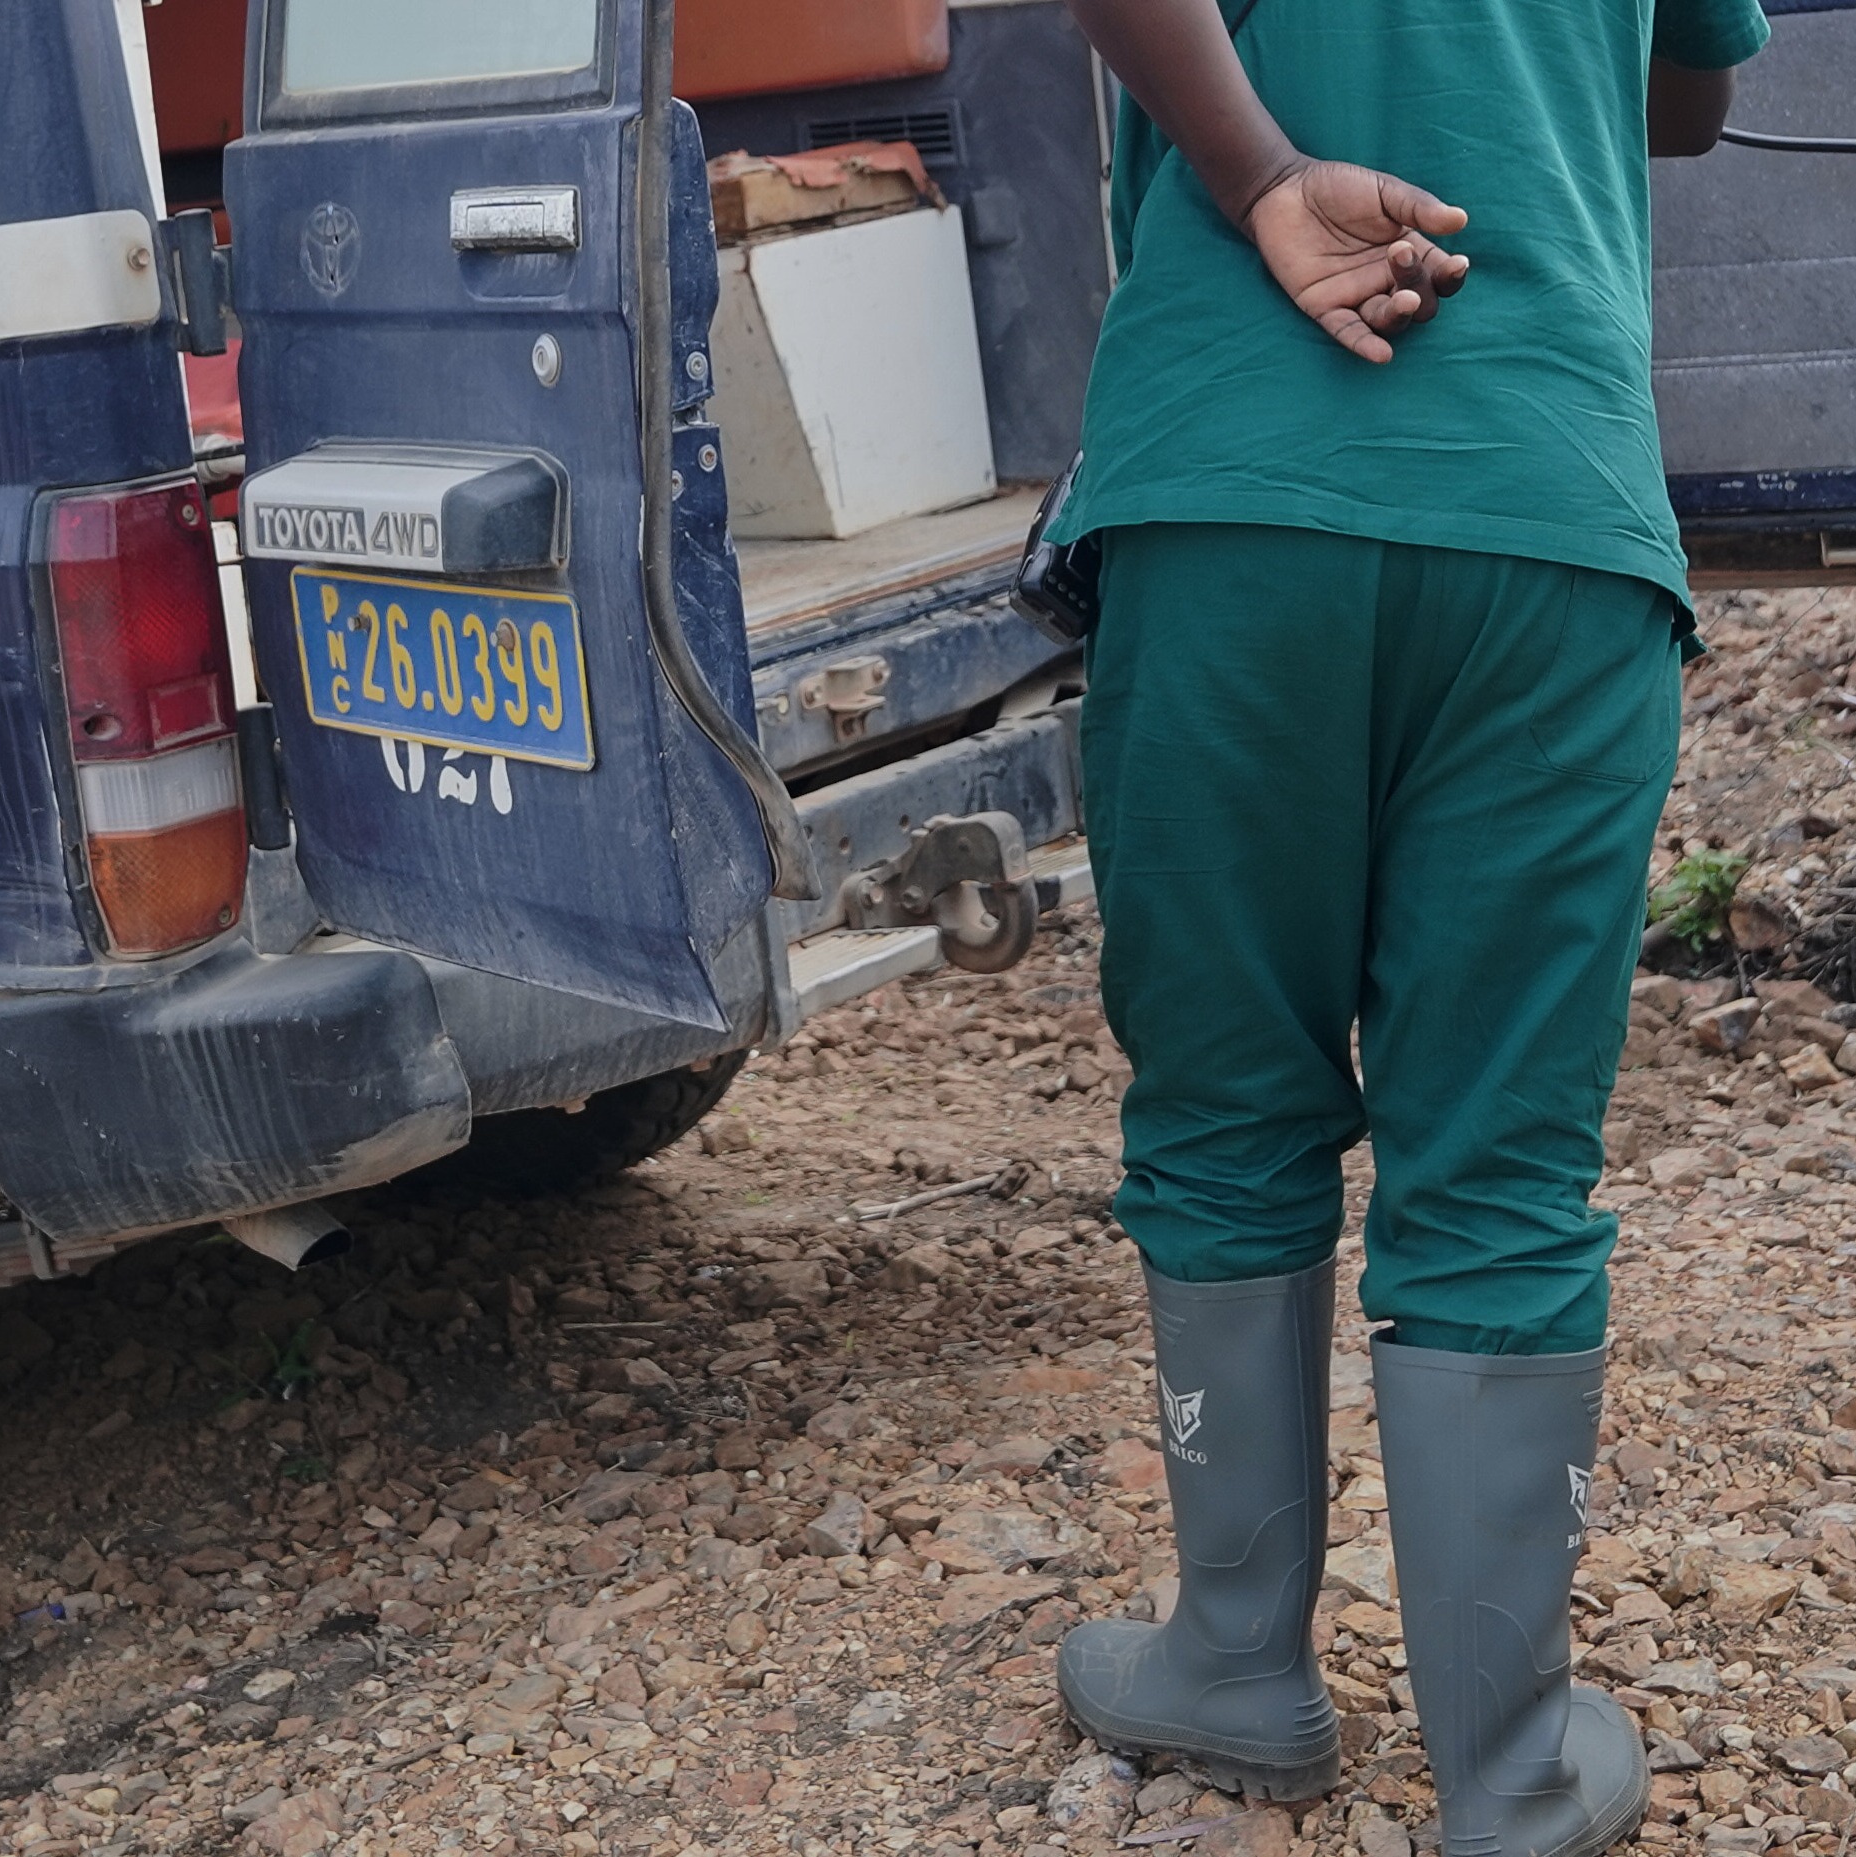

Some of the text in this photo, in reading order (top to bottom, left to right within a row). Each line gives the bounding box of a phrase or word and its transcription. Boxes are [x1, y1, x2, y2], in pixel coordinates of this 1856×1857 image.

[258, 507, 440, 558] TOYOTA 4WD
[357, 599, 564, 732] 26.0399
